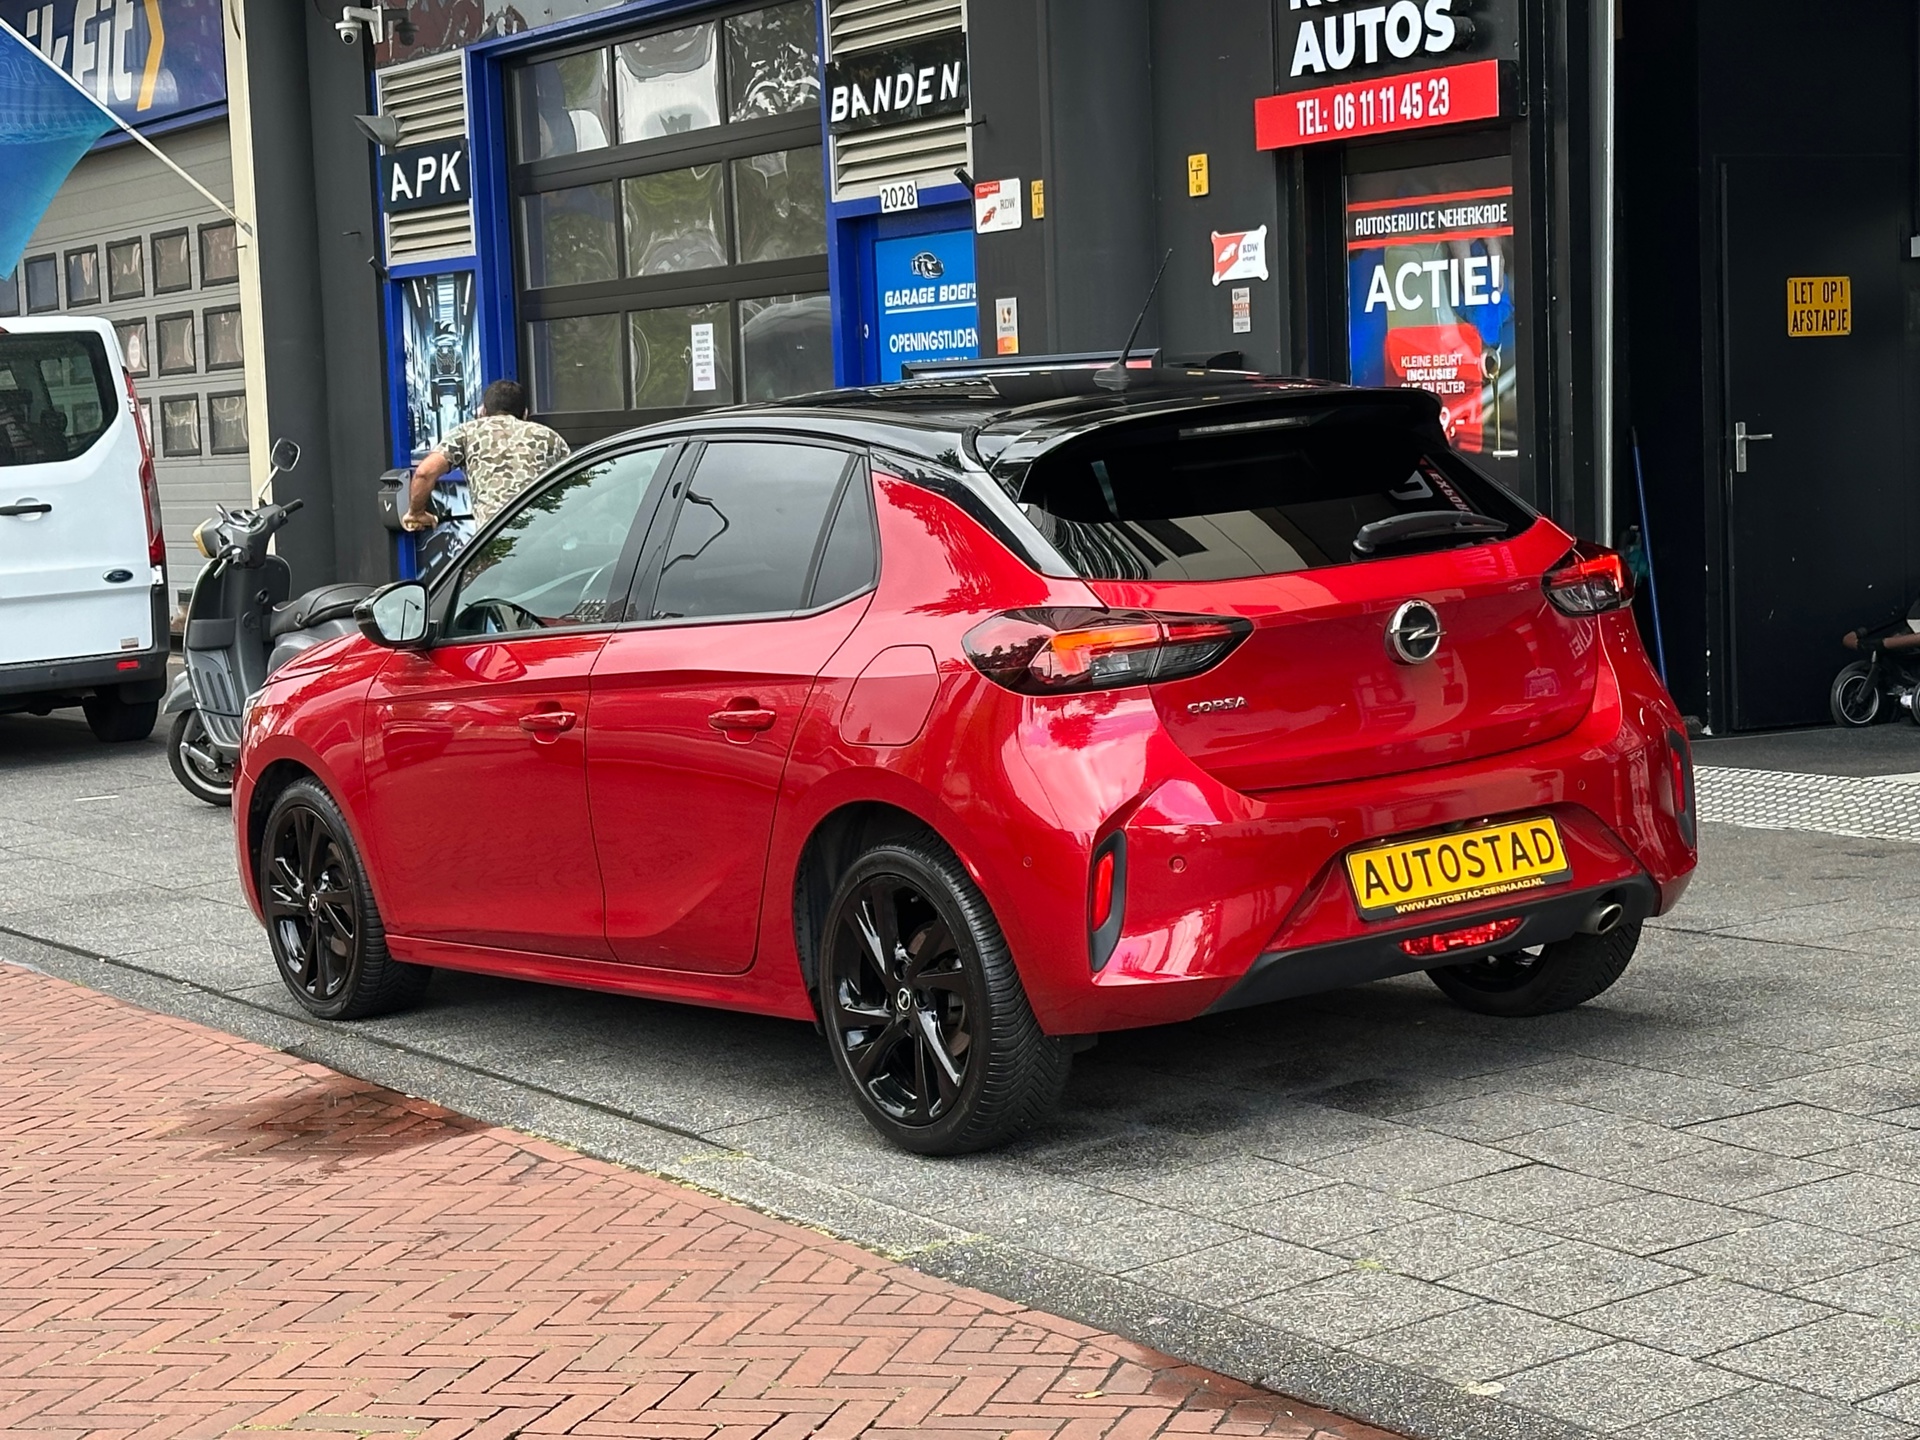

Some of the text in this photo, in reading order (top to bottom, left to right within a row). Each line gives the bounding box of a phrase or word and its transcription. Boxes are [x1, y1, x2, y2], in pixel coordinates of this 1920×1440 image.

[1290, 0, 1456, 77] AUTOS
[831, 61, 961, 123] BANDEN
[1297, 77, 1449, 136] TEL: 06 11 11 45 23
[391, 150, 462, 202] APK
[881, 184, 915, 210] 2028
[1355, 203, 1508, 236] AUTOSERVICE NEHERKADE
[1242, 244, 1258, 254] RDW
[884, 286, 936, 308] GARAGE
[1364, 255, 1501, 313] ACTIE!
[1793, 281, 1844, 304] LET OP!
[1791, 308, 1848, 332] AFSTAPJE
[889, 327, 978, 353] OPENINGSTIJDEN
[1401, 353, 1463, 368] KLEINE BEURT
[1406, 367, 1458, 381] INCLUSIEF
[1436, 381, 1466, 394] FILTER
[1187, 696, 1248, 713] CORSA
[1365, 827, 1555, 900] AUTOSTAD
[1394, 878, 1546, 914] WWW.AUTOSTAD-DENHAAG.NL
